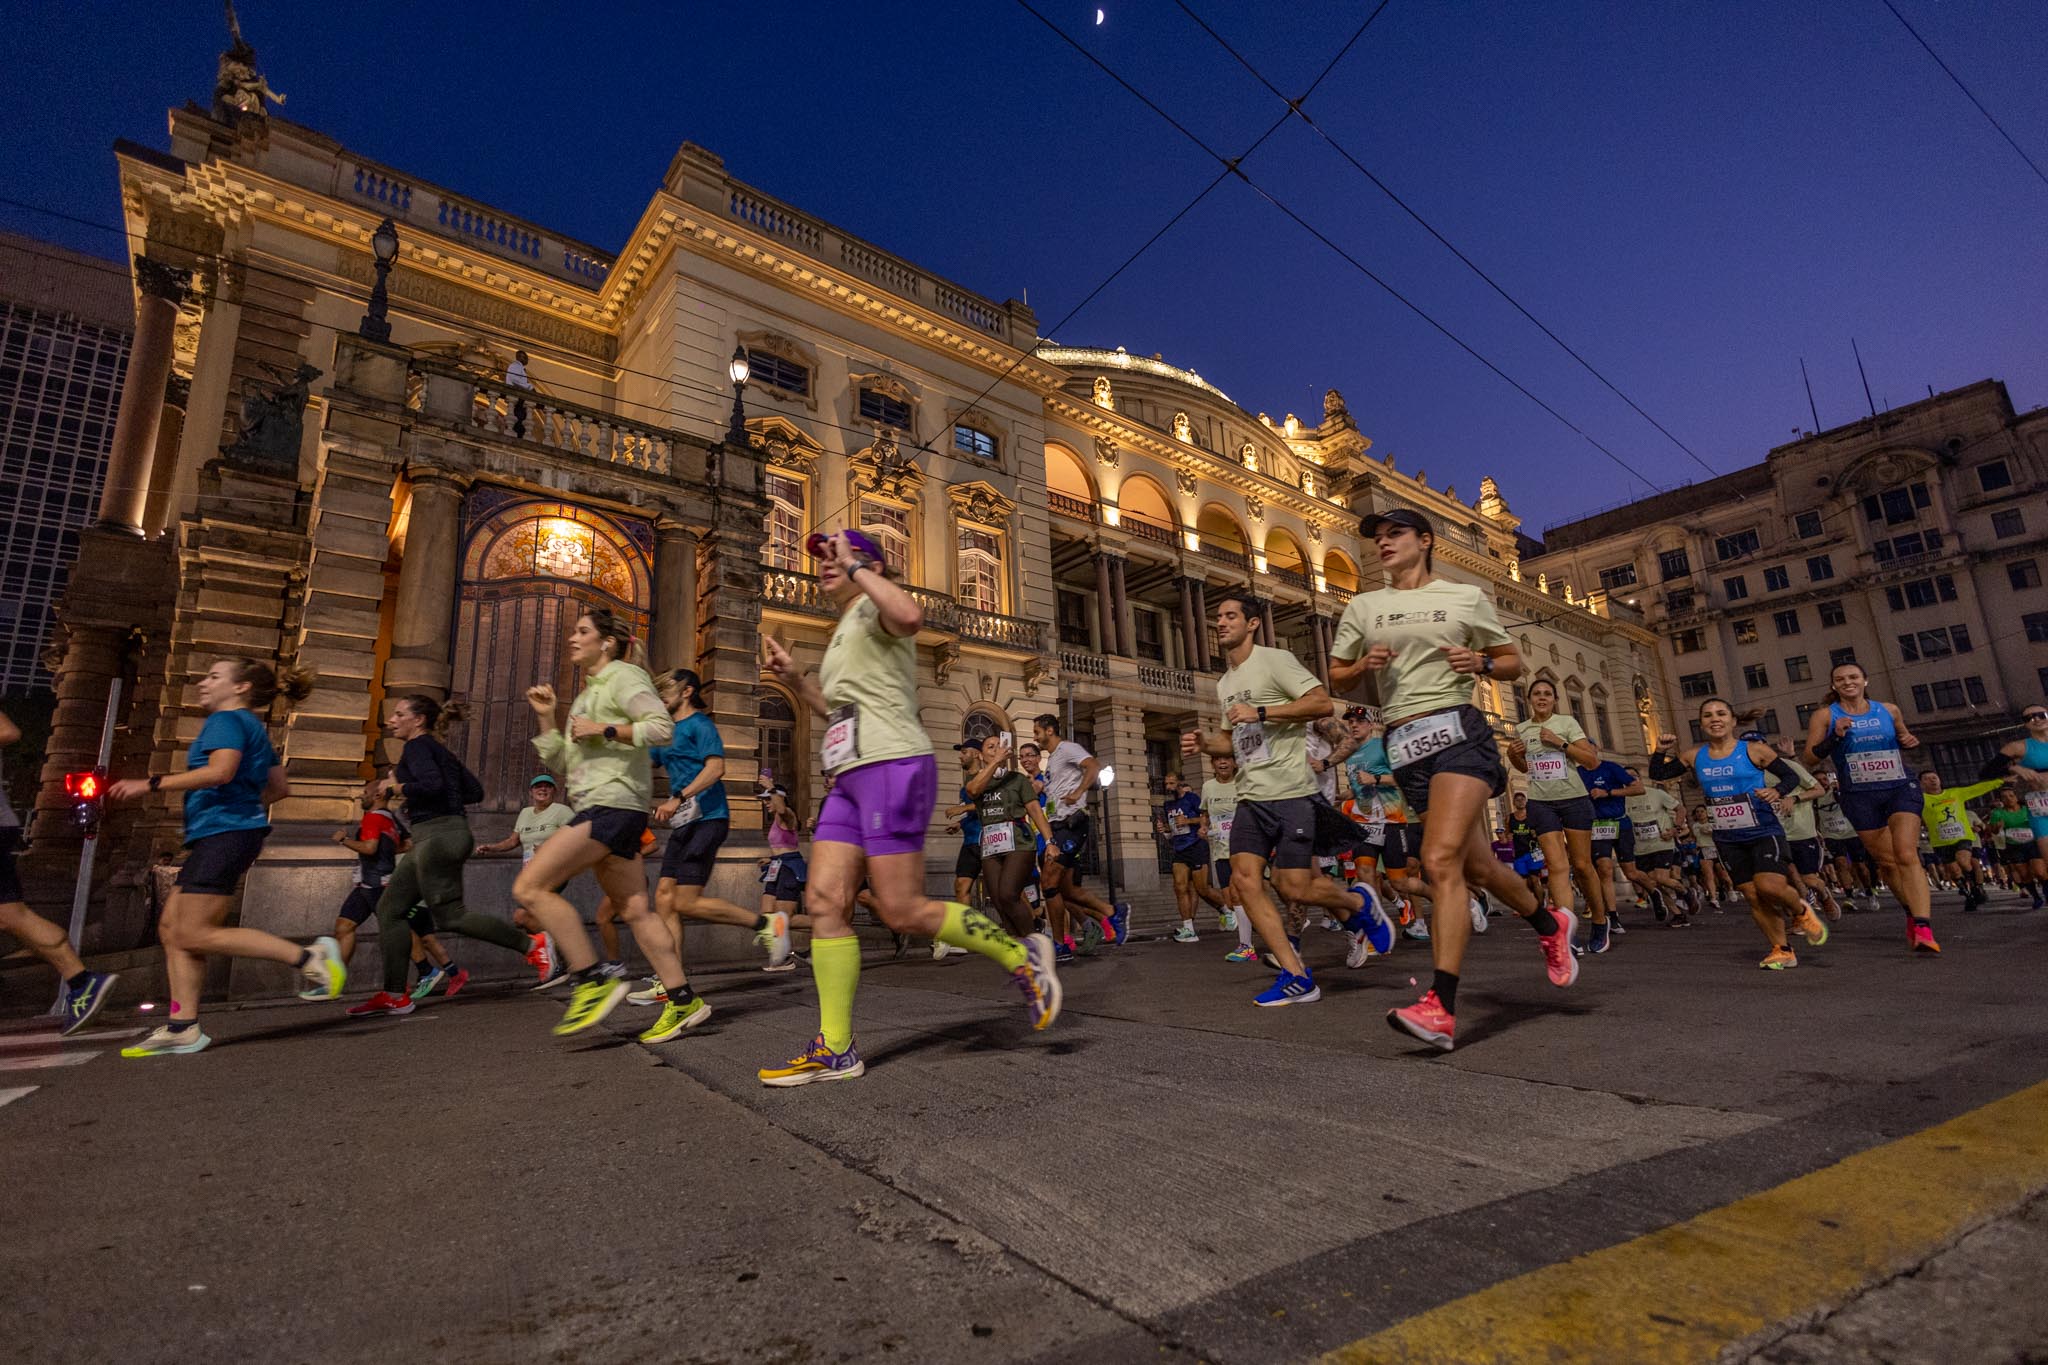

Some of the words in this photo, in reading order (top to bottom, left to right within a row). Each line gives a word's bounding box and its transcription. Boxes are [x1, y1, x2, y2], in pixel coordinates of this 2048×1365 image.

[1402, 728, 1452, 759] 13545
[1535, 761, 1561, 770] 19970
[1861, 760, 1895, 771] 15201
[1715, 805, 1744, 818] 2328
[1221, 821, 1233, 831] 85
[986, 832, 1008, 845] 10801
